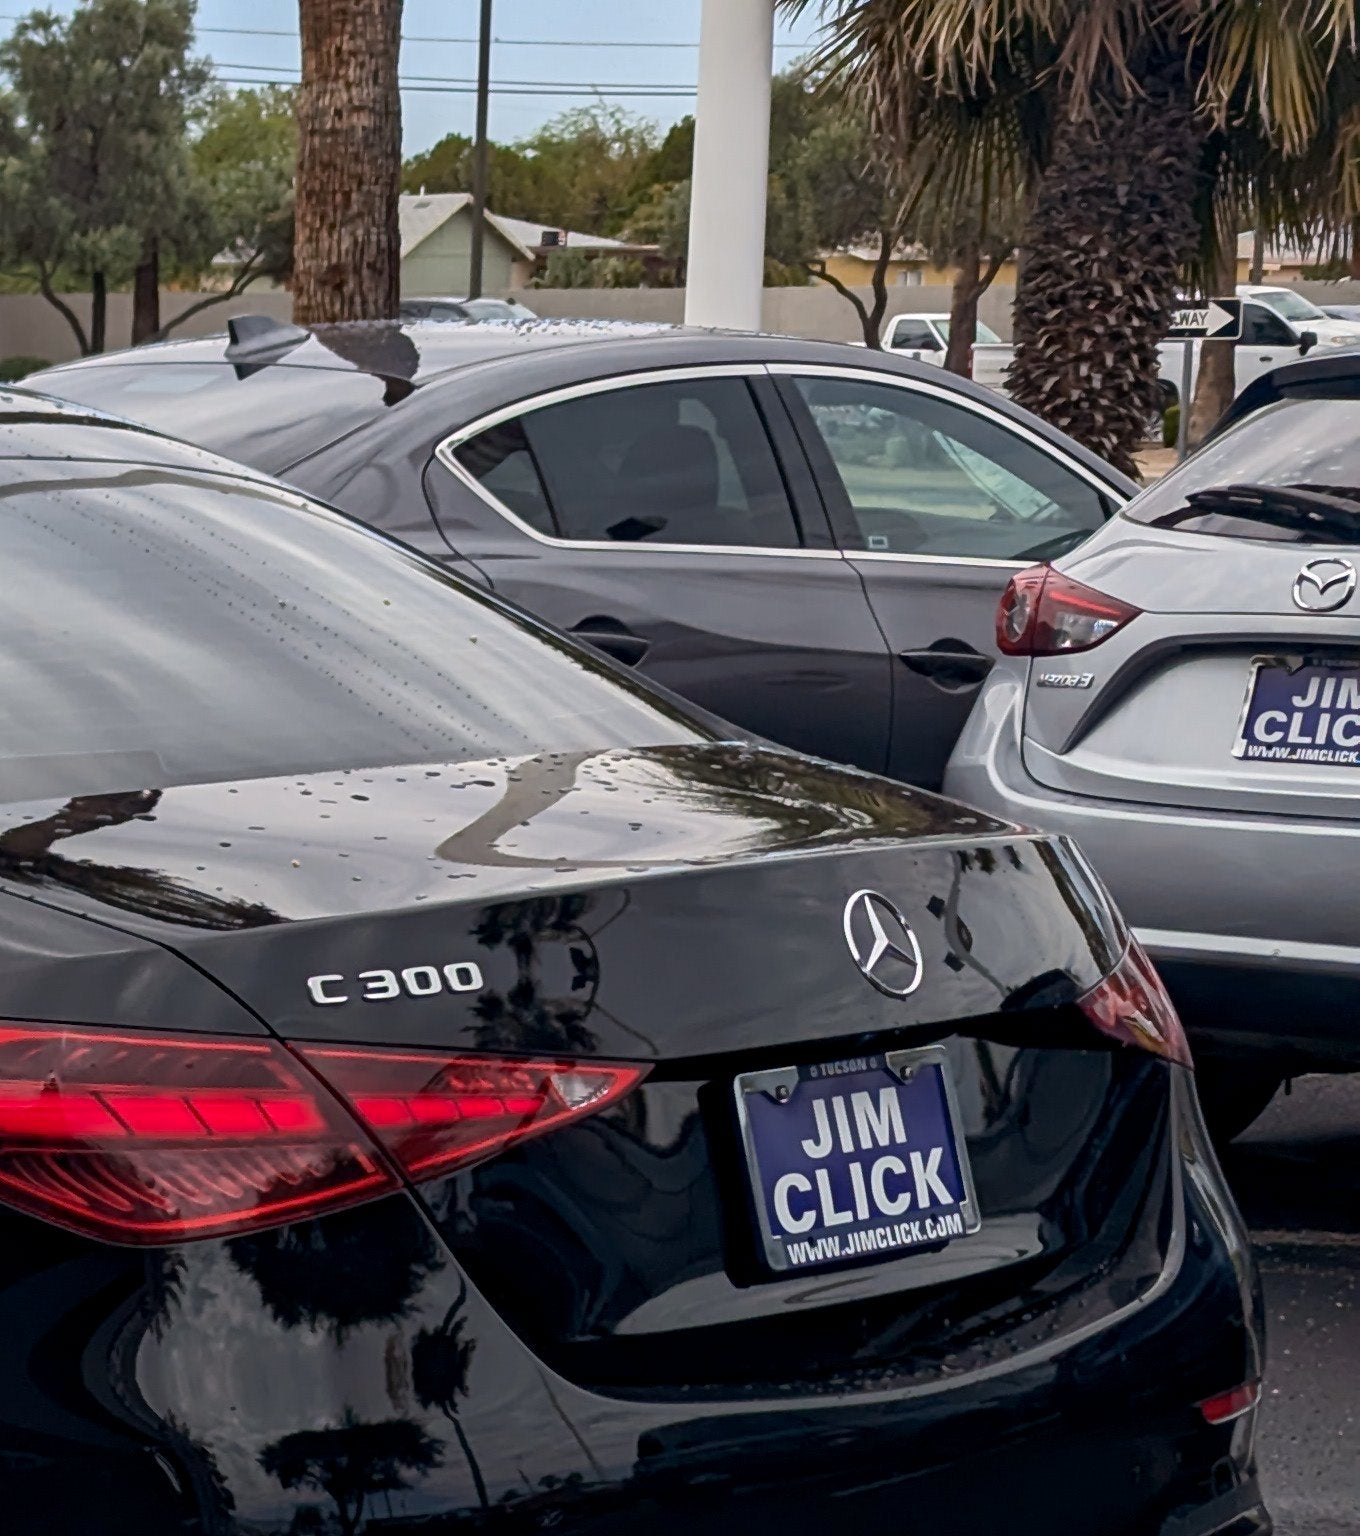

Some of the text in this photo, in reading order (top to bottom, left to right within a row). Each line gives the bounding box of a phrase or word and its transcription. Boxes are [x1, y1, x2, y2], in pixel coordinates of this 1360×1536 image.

[1179, 311, 1209, 326] WAY
[307, 961, 484, 1004] C 300
[821, 1059, 867, 1076] TUCSON
[801, 1086, 907, 1159] JIM
[773, 1146, 955, 1235] CLICK
[786, 1212, 964, 1265] WWW.JIMCLICK.COM
